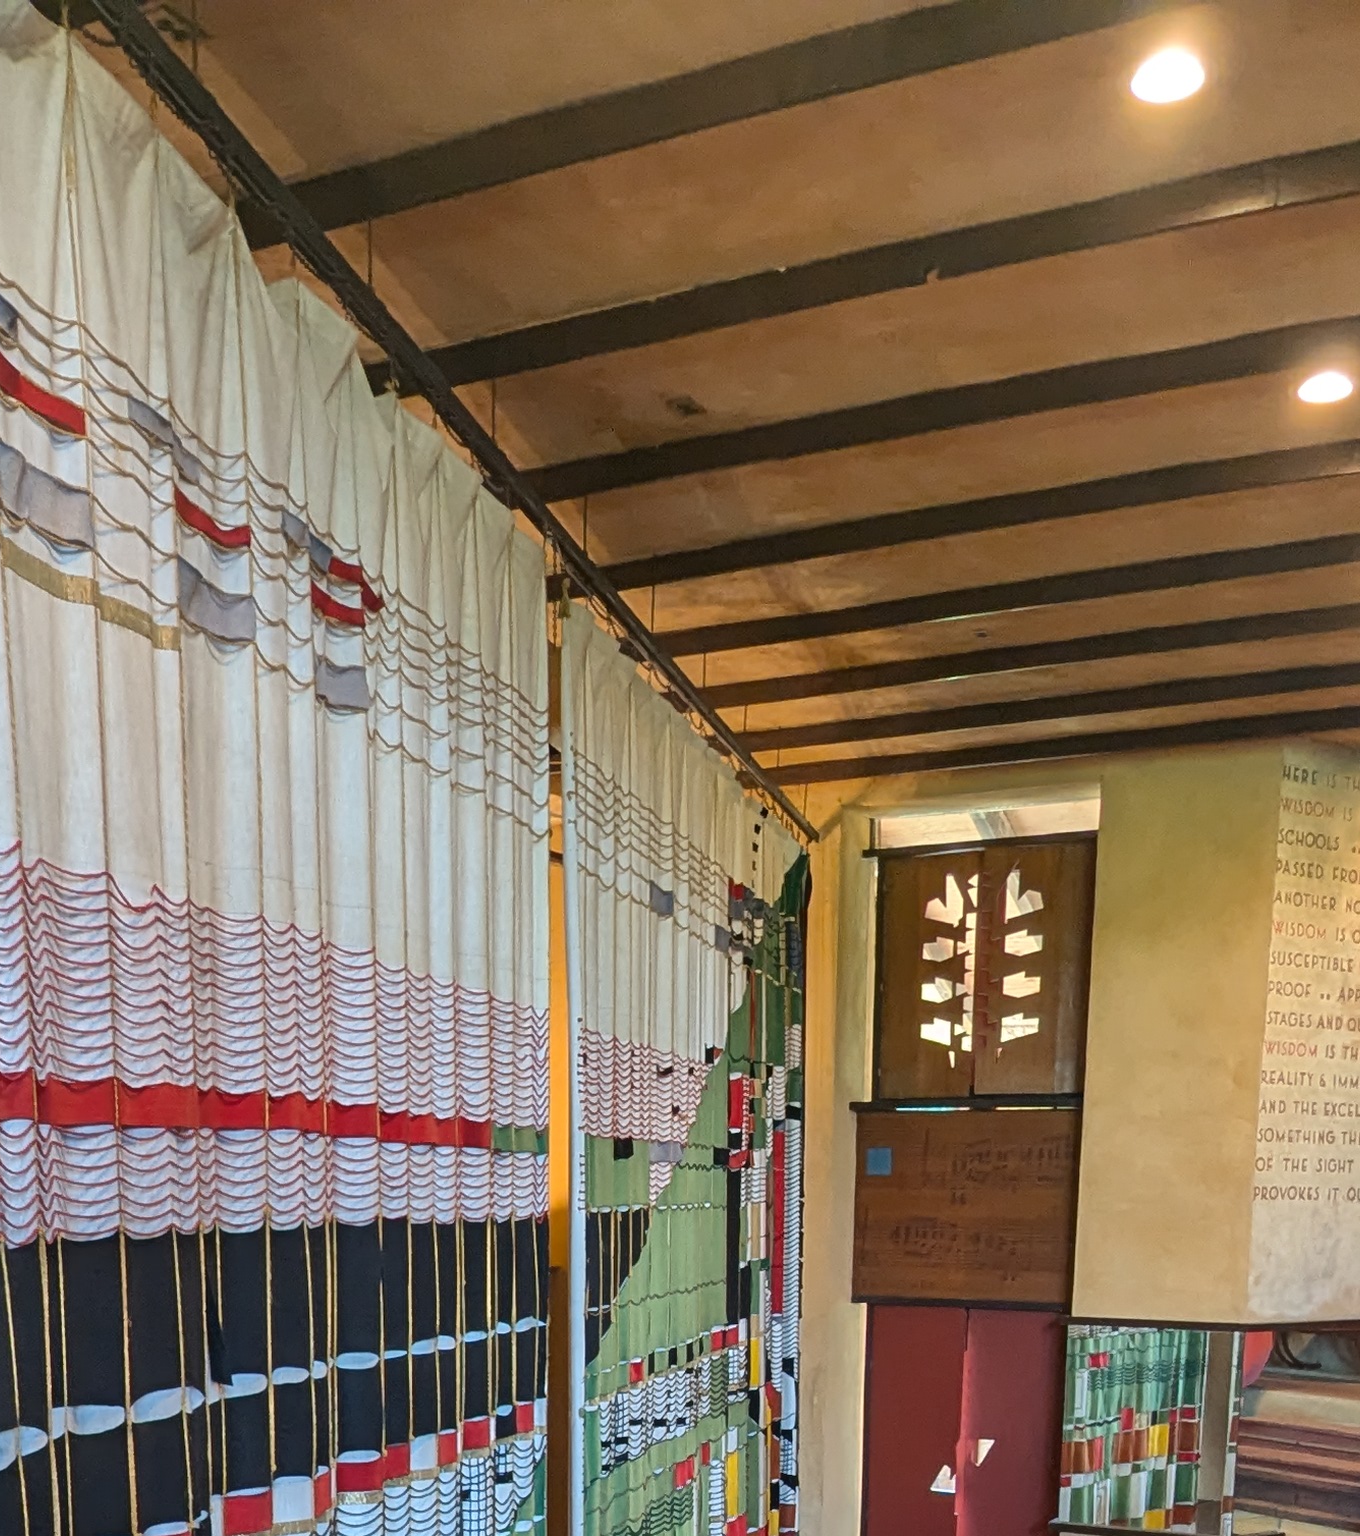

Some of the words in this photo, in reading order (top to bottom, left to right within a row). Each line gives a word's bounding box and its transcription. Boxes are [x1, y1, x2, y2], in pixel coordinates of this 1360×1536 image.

[1283, 765, 1318, 785] HERE
[1327, 774, 1336, 788] IS
[1281, 797, 1335, 818] WISDOM
[1343, 807, 1352, 822] IS
[1278, 828, 1339, 851] SCHOOLS
[1276, 859, 1324, 879] PASSED
[1274, 890, 1336, 911] ANOTHER
[1273, 920, 1326, 939] WISDOM
[1336, 925, 1345, 942] IS
[1270, 950, 1354, 973] SUSCEPTIBLE
[1268, 980, 1311, 998] PROOF
[1266, 1010, 1312, 1029] STAGES
[1316, 1016, 1343, 1030] AND
[1263, 1041, 1317, 1057] WISDOM
[1325, 1045, 1335, 1058] IS
[1261, 1071, 1314, 1086] REALITY
[1319, 1075, 1326, 1087] &
[1259, 1099, 1286, 1115] AND
[1293, 1101, 1317, 1116] THE
[1256, 1127, 1335, 1145] SOMETHING
[1255, 1157, 1273, 1172] OF
[1283, 1158, 1307, 1172] THE
[1315, 1158, 1354, 1174] SIGHT
[1253, 1185, 1319, 1201] PROVOKES
[1328, 1187, 1340, 1201] IT
